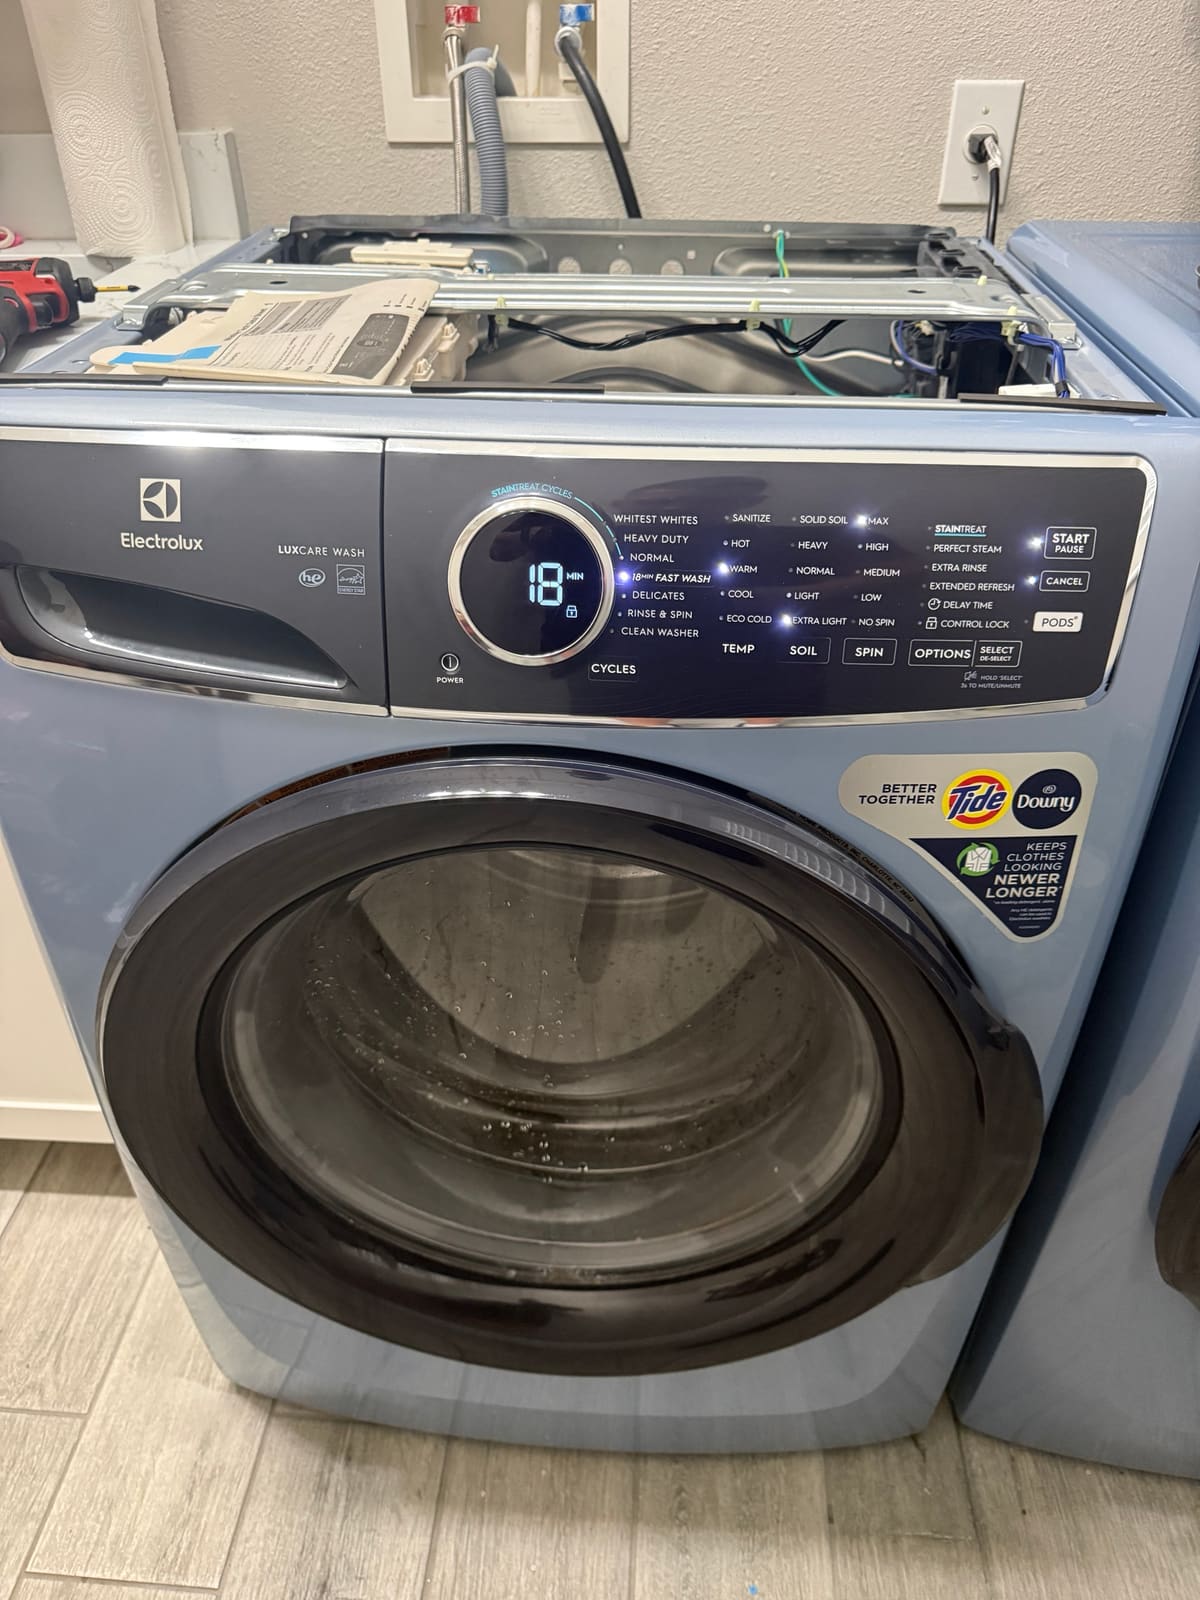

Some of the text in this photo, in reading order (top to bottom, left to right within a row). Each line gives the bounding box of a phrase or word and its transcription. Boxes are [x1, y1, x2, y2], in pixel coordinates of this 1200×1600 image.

[491, 482, 573, 499] STAINTREAT CYCLES
[614, 514, 698, 526] WHITEST WHITES
[732, 514, 771, 523] SANITIZE
[799, 515, 848, 524] SOLID SOIL
[867, 517, 889, 525] MAX
[935, 524, 987, 534] STAINTREAT
[120, 531, 204, 551] Electrolux
[624, 533, 689, 545] HEAVY DUTY
[731, 539, 750, 548] HOT
[1052, 533, 1090, 544] START
[798, 541, 828, 550] HEAVY
[865, 542, 889, 551] HIGH
[934, 544, 1002, 554] PERFECT STEAM
[1055, 545, 1084, 554] PAUSE
[278, 544, 365, 558] LUXCARE WASH
[630, 552, 675, 563] NORMAL
[729, 565, 757, 574] WARM
[796, 567, 835, 576] NORMAL
[863, 568, 900, 577] MEDIUM
[931, 563, 988, 573] EXTRA RINSE
[655, 573, 679, 582] FAST
[682, 574, 711, 583] WASH
[1046, 577, 1083, 586] CANCEL
[529, 562, 584, 606] 18 MIN
[929, 582, 1015, 592] EXTENDED REFRESH
[632, 591, 685, 601] DELICATES
[728, 590, 754, 599] COOL
[794, 592, 820, 601] LIGHT
[861, 593, 882, 602] LOW
[943, 601, 993, 610] DELAY TIME
[627, 609, 693, 620] RINSE & SPIN
[726, 614, 772, 624] ECO COLD
[792, 616, 847, 626] EXTRA LIGHT
[858, 618, 895, 627] NO SPIN
[941, 619, 1010, 629] CONTROL LOCK
[621, 626, 699, 638] CLEAN WASHER
[722, 643, 755, 654] TEMP
[790, 645, 818, 656] SOIL
[855, 647, 884, 657] SPIN
[980, 646, 1015, 655] SELECT
[914, 648, 971, 660] OPTIONS
[591, 663, 636, 675] CYCLES
[436, 676, 464, 684] POWER
[882, 783, 937, 794] BETTER
[858, 795, 936, 805] TOGETHER
[945, 783, 1008, 822] Tide
[1017, 794, 1075, 812] Downy
[1027, 842, 1068, 851] KEEPS
[1006, 852, 1065, 862] CLOTHES
[1004, 862, 1062, 872] LOOKING
[994, 874, 1060, 886] NEWER
